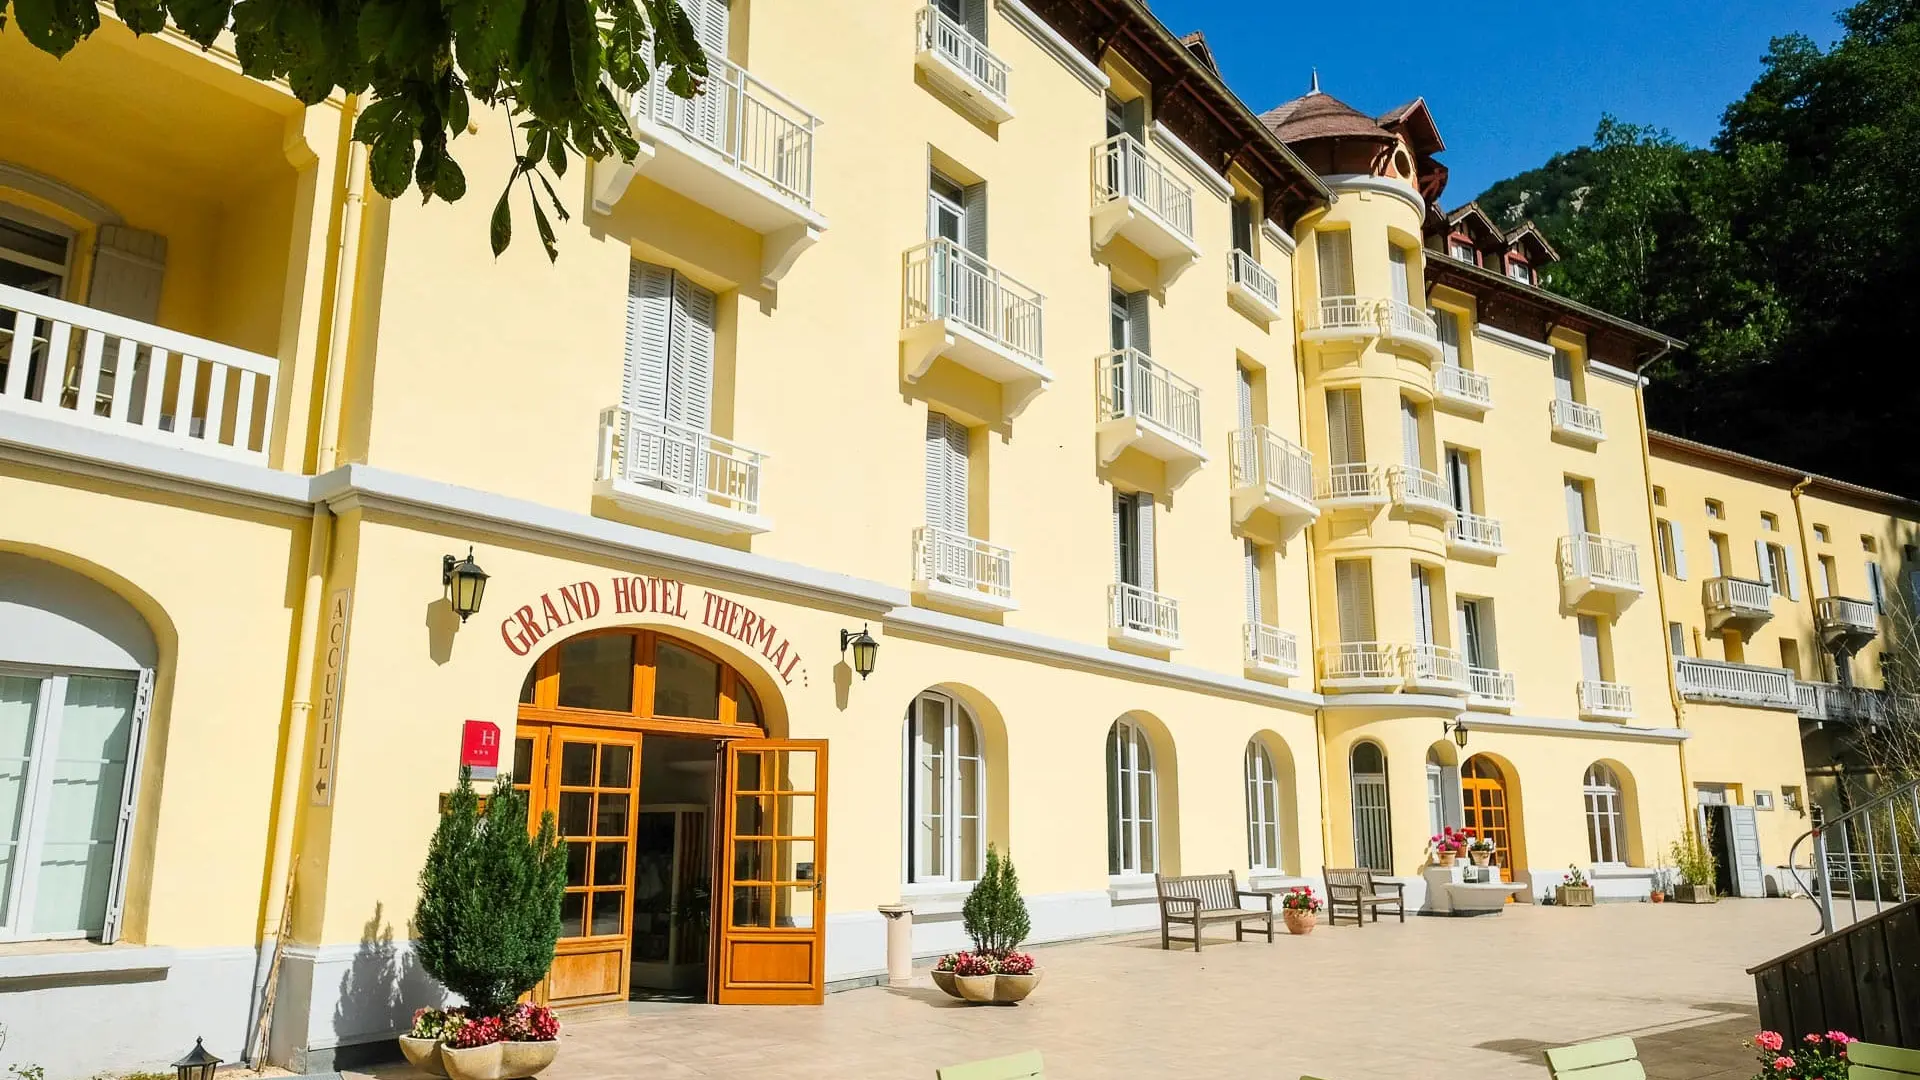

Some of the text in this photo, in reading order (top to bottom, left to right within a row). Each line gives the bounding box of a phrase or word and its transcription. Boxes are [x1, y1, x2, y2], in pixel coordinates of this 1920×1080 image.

[318, 597, 343, 770] ACCUEIL
[500, 576, 801, 686] GRAND HOTEL THERMAL
[481, 729, 496, 746] H
